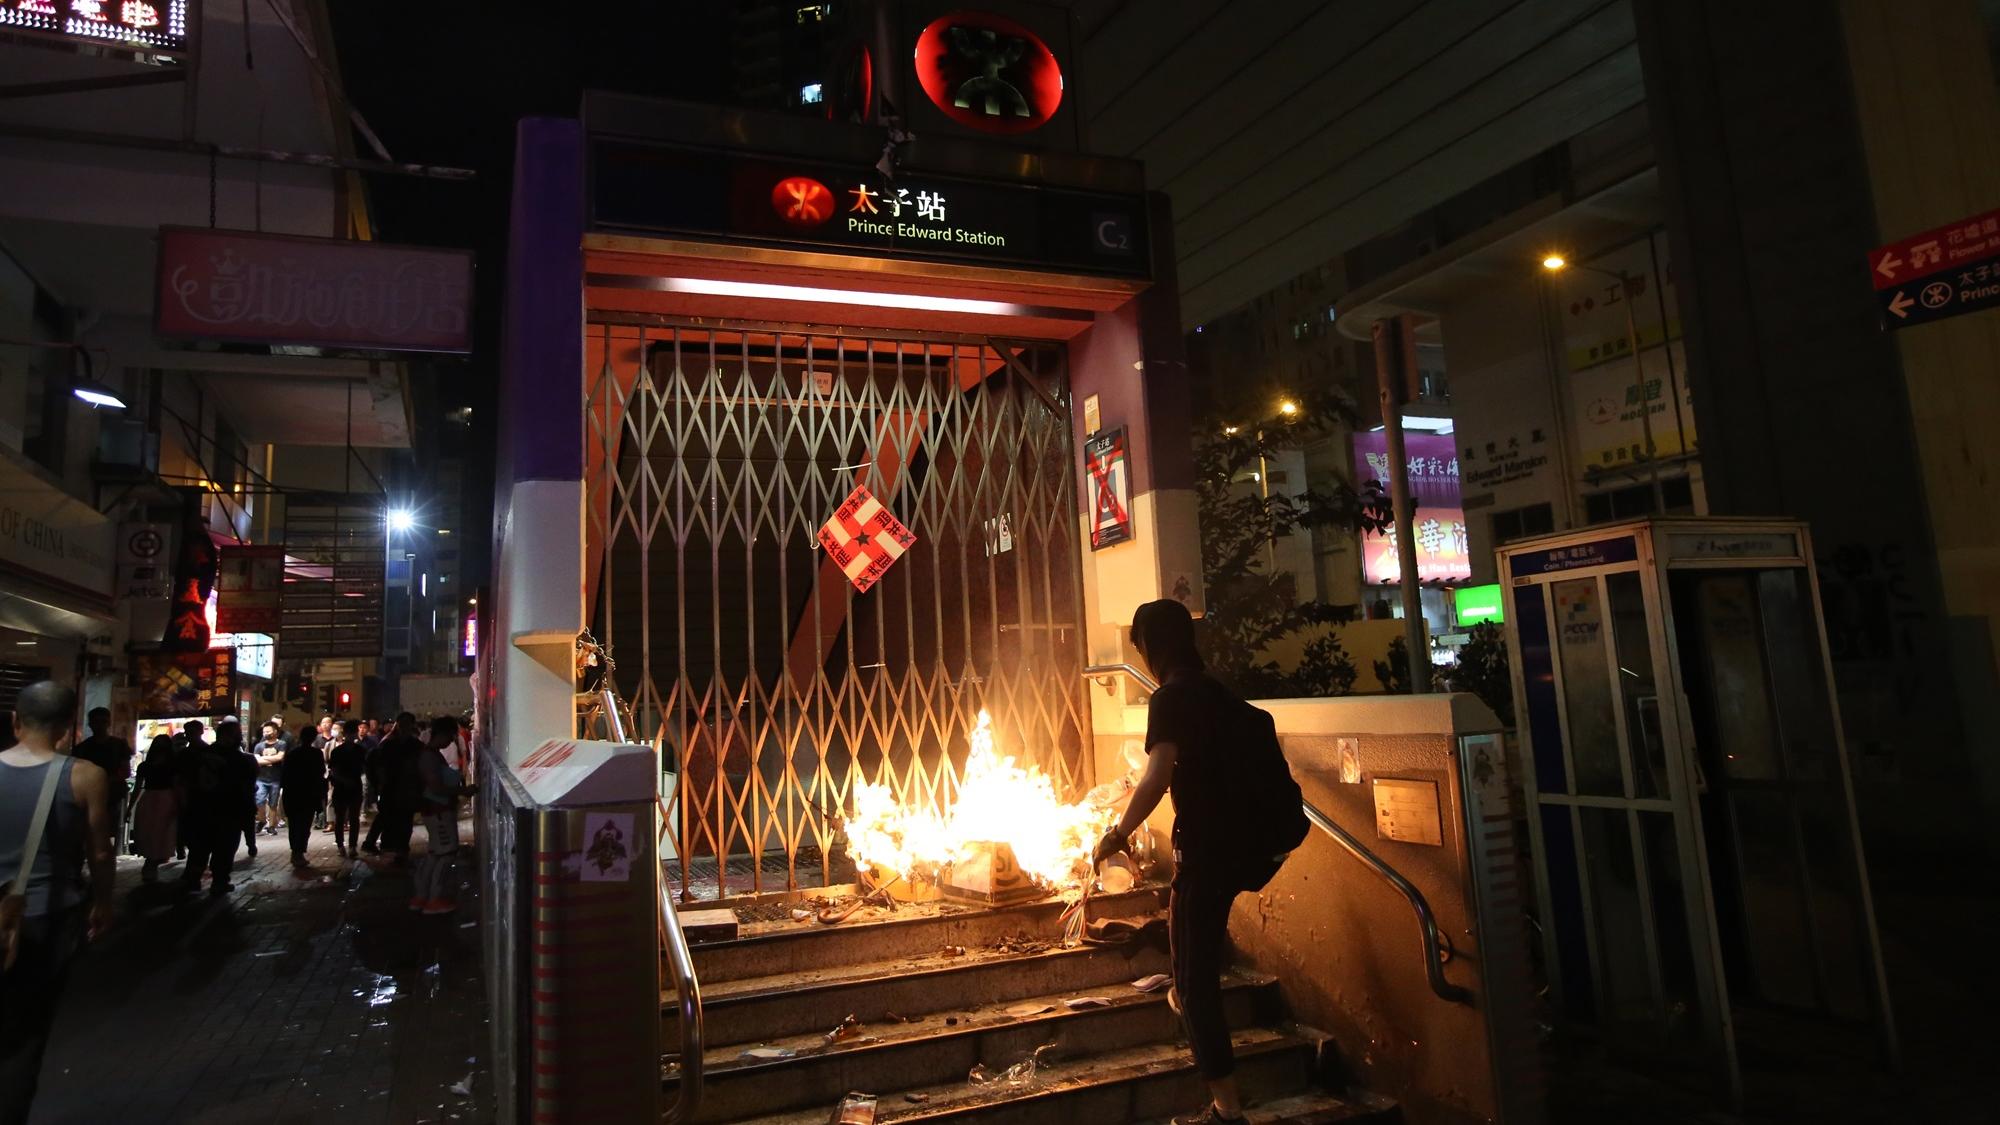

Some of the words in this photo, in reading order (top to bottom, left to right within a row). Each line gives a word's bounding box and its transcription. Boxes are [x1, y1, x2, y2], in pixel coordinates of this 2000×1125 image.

[848, 183, 947, 222] 太子站
[848, 218, 893, 237] Prince
[897, 222, 952, 243] Edward
[955, 226, 1005, 248] Station
[1467, 464, 1502, 483] Edward
[1504, 455, 1548, 475] Mansion
[2, 507, 21, 539] OF
[23, 517, 65, 559] CHINA
